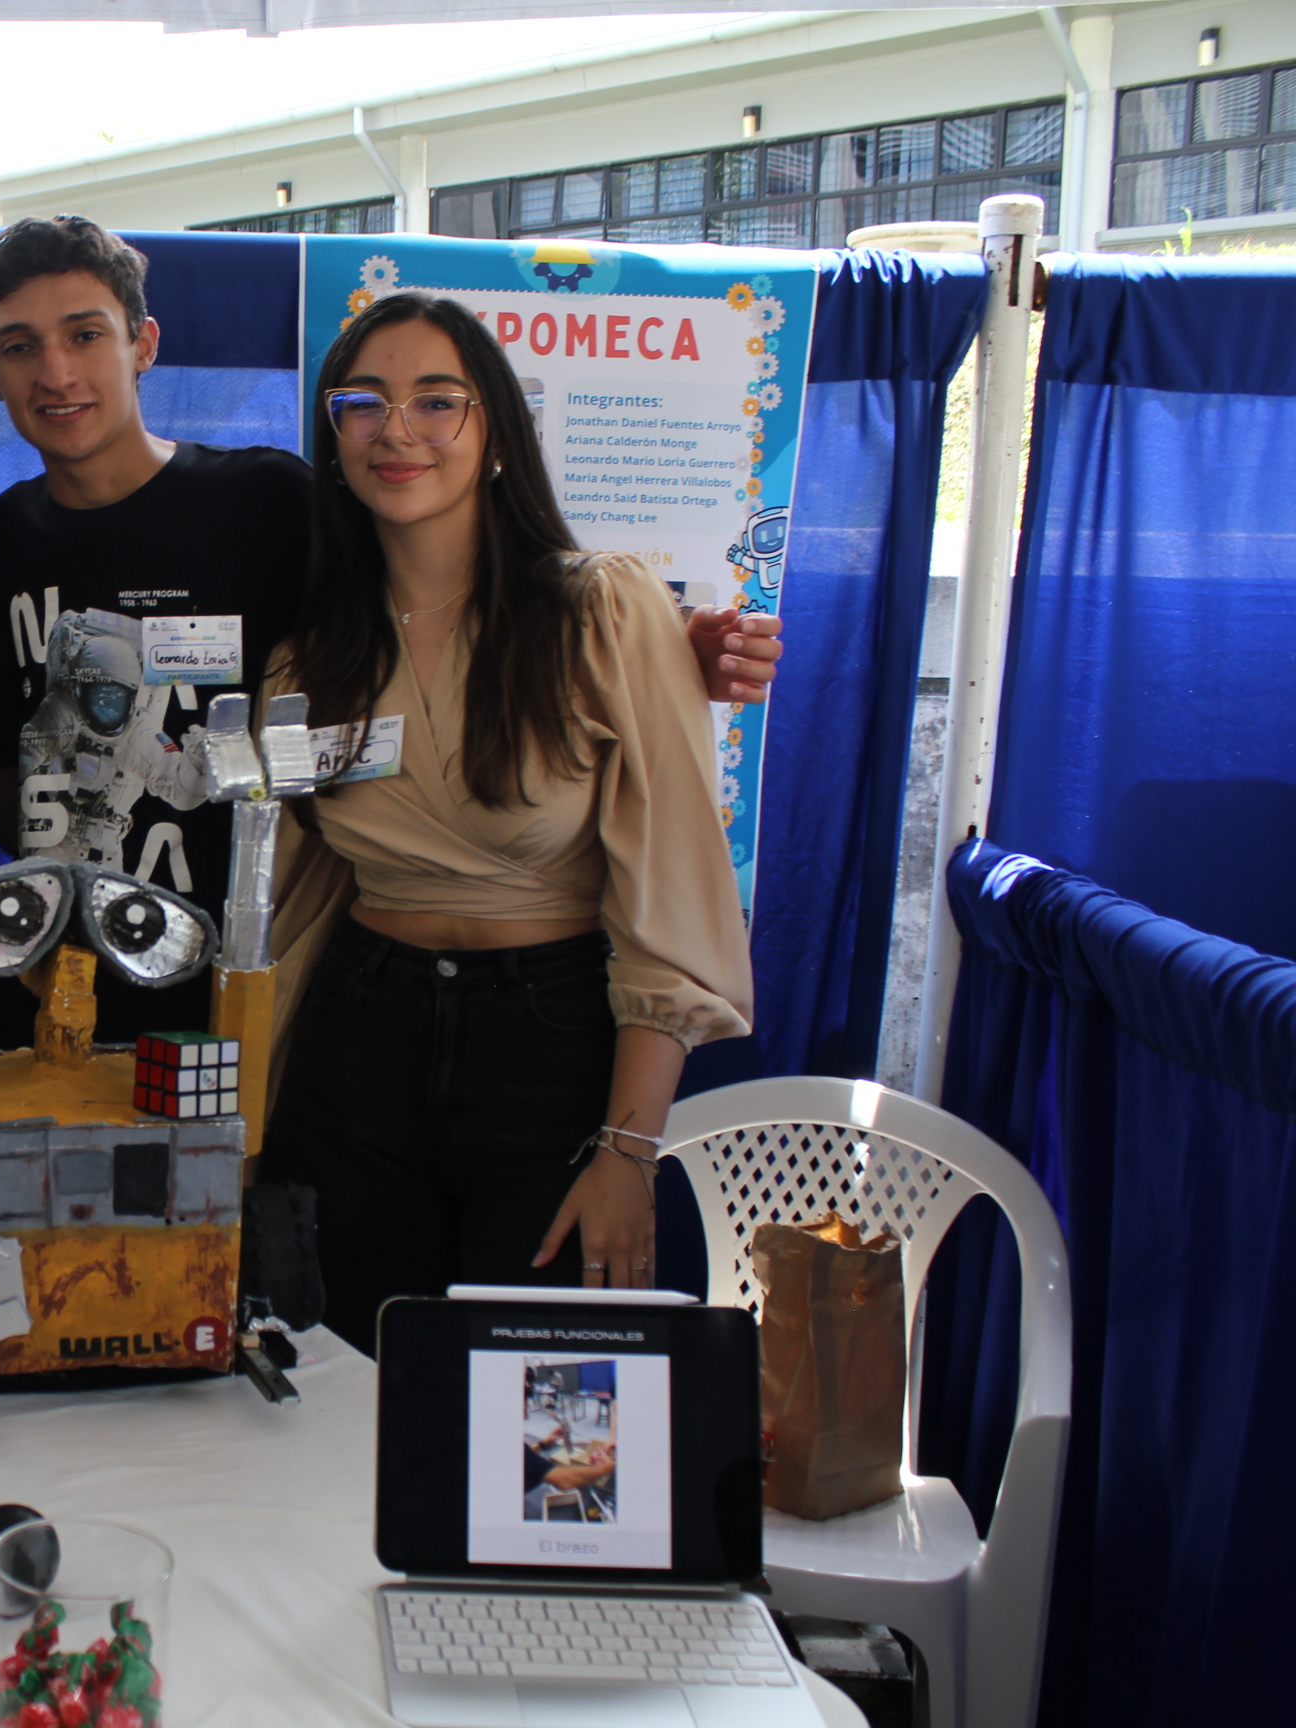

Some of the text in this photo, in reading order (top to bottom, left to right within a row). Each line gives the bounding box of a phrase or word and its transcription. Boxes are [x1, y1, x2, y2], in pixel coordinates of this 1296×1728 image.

[476, 311, 701, 361] POMECA
[567, 392, 663, 410] Integrantes:
[565, 416, 742, 434] Jonathan Daniel Fuentes Arroyo
[565, 435, 698, 451] Ariana Calderón Monge
[565, 454, 619, 465] Leonardo
[622, 456, 655, 466] Mario
[689, 458, 736, 469] Guerrero
[601, 474, 632, 486] Angel
[635, 475, 679, 486] Herrera
[681, 476, 732, 488] Villalobos
[564, 492, 718, 508] Leandro Said Batista Ortega
[563, 510, 658, 524] Sandy Chang Lee
[118, 590, 189, 598] MERCURY PROGRAM
[155, 650, 199, 665] Leonardo
[491, 1327, 645, 1342] PRUEBAS FUNCIONALES
[540, 1540, 600, 1555] El brazo
